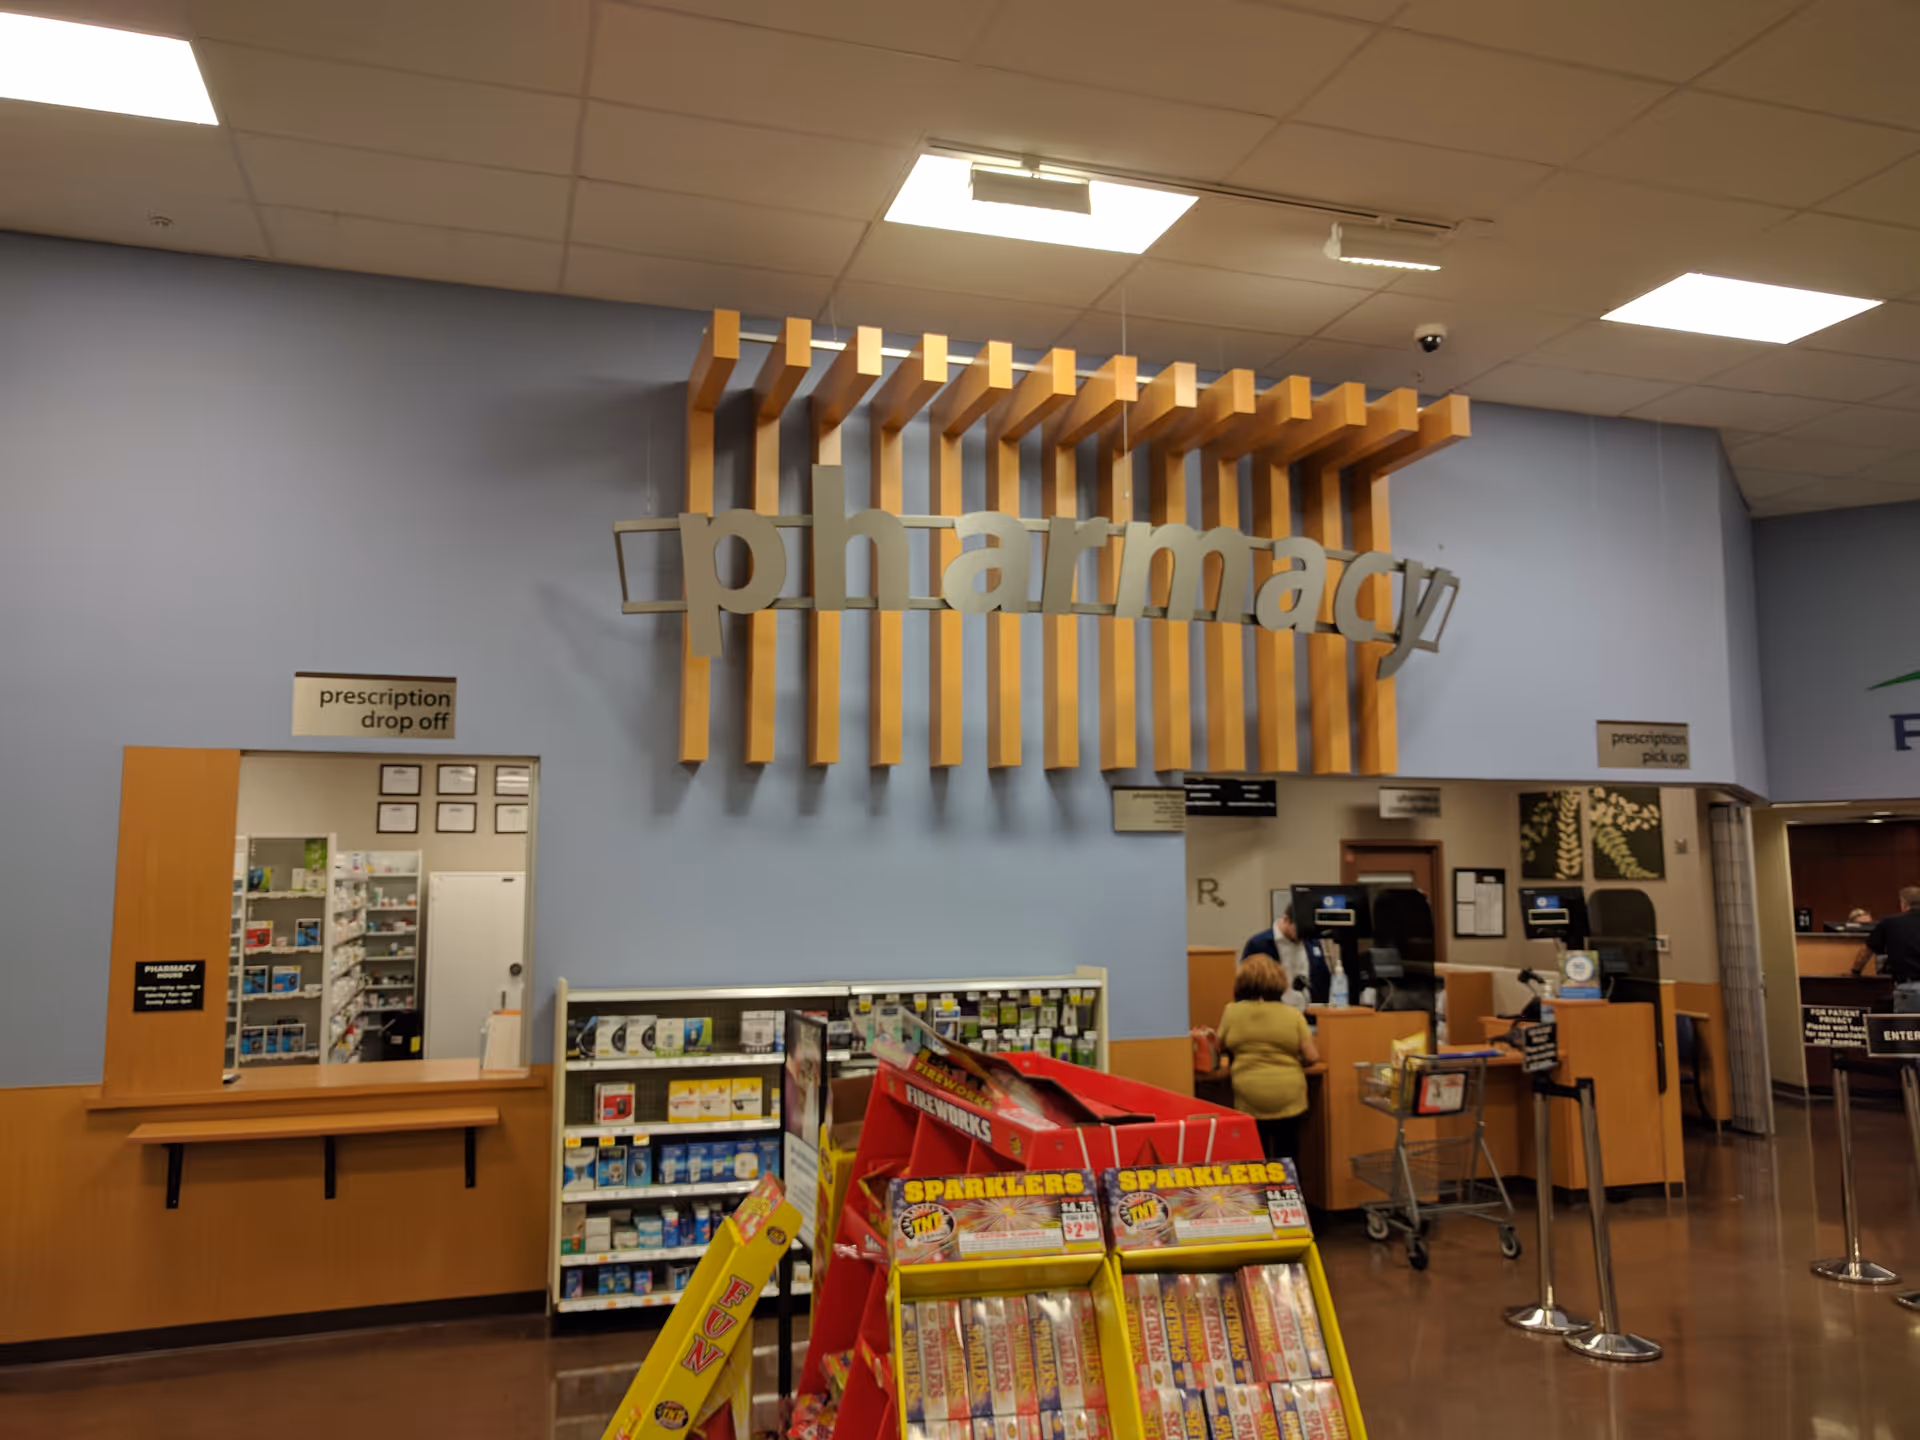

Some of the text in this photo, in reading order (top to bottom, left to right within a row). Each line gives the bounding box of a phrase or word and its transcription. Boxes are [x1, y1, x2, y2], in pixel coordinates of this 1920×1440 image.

[679, 464, 1456, 679] pharmacy
[320, 688, 451, 710] prescription
[361, 710, 450, 734] drop off
[1611, 731, 1687, 749] prescription
[1642, 751, 1687, 766] pick up
[144, 964, 197, 973] PHARMACY
[1828, 1009, 1860, 1017] PATIENT
[1883, 1030, 1920, 1041] ENTER
[914, 1062, 993, 1110] FIREWORKS
[906, 1083, 992, 1143] FIREWORKS
[903, 1172, 1085, 1203] SPARKLERS
[1118, 1162, 1287, 1191] SPARKLERS
[1061, 1201, 1096, 1212] $4.75
[1266, 1189, 1299, 1200] $4.75
[912, 1211, 942, 1235] TNT
[1129, 1200, 1157, 1222] TNT
[681, 1275, 754, 1375] FUN
[1142, 1294, 1168, 1363] SPARKLERS
[1163, 1293, 1188, 1363] SPARKLERS
[1223, 1293, 1249, 1362] SPARKLERS
